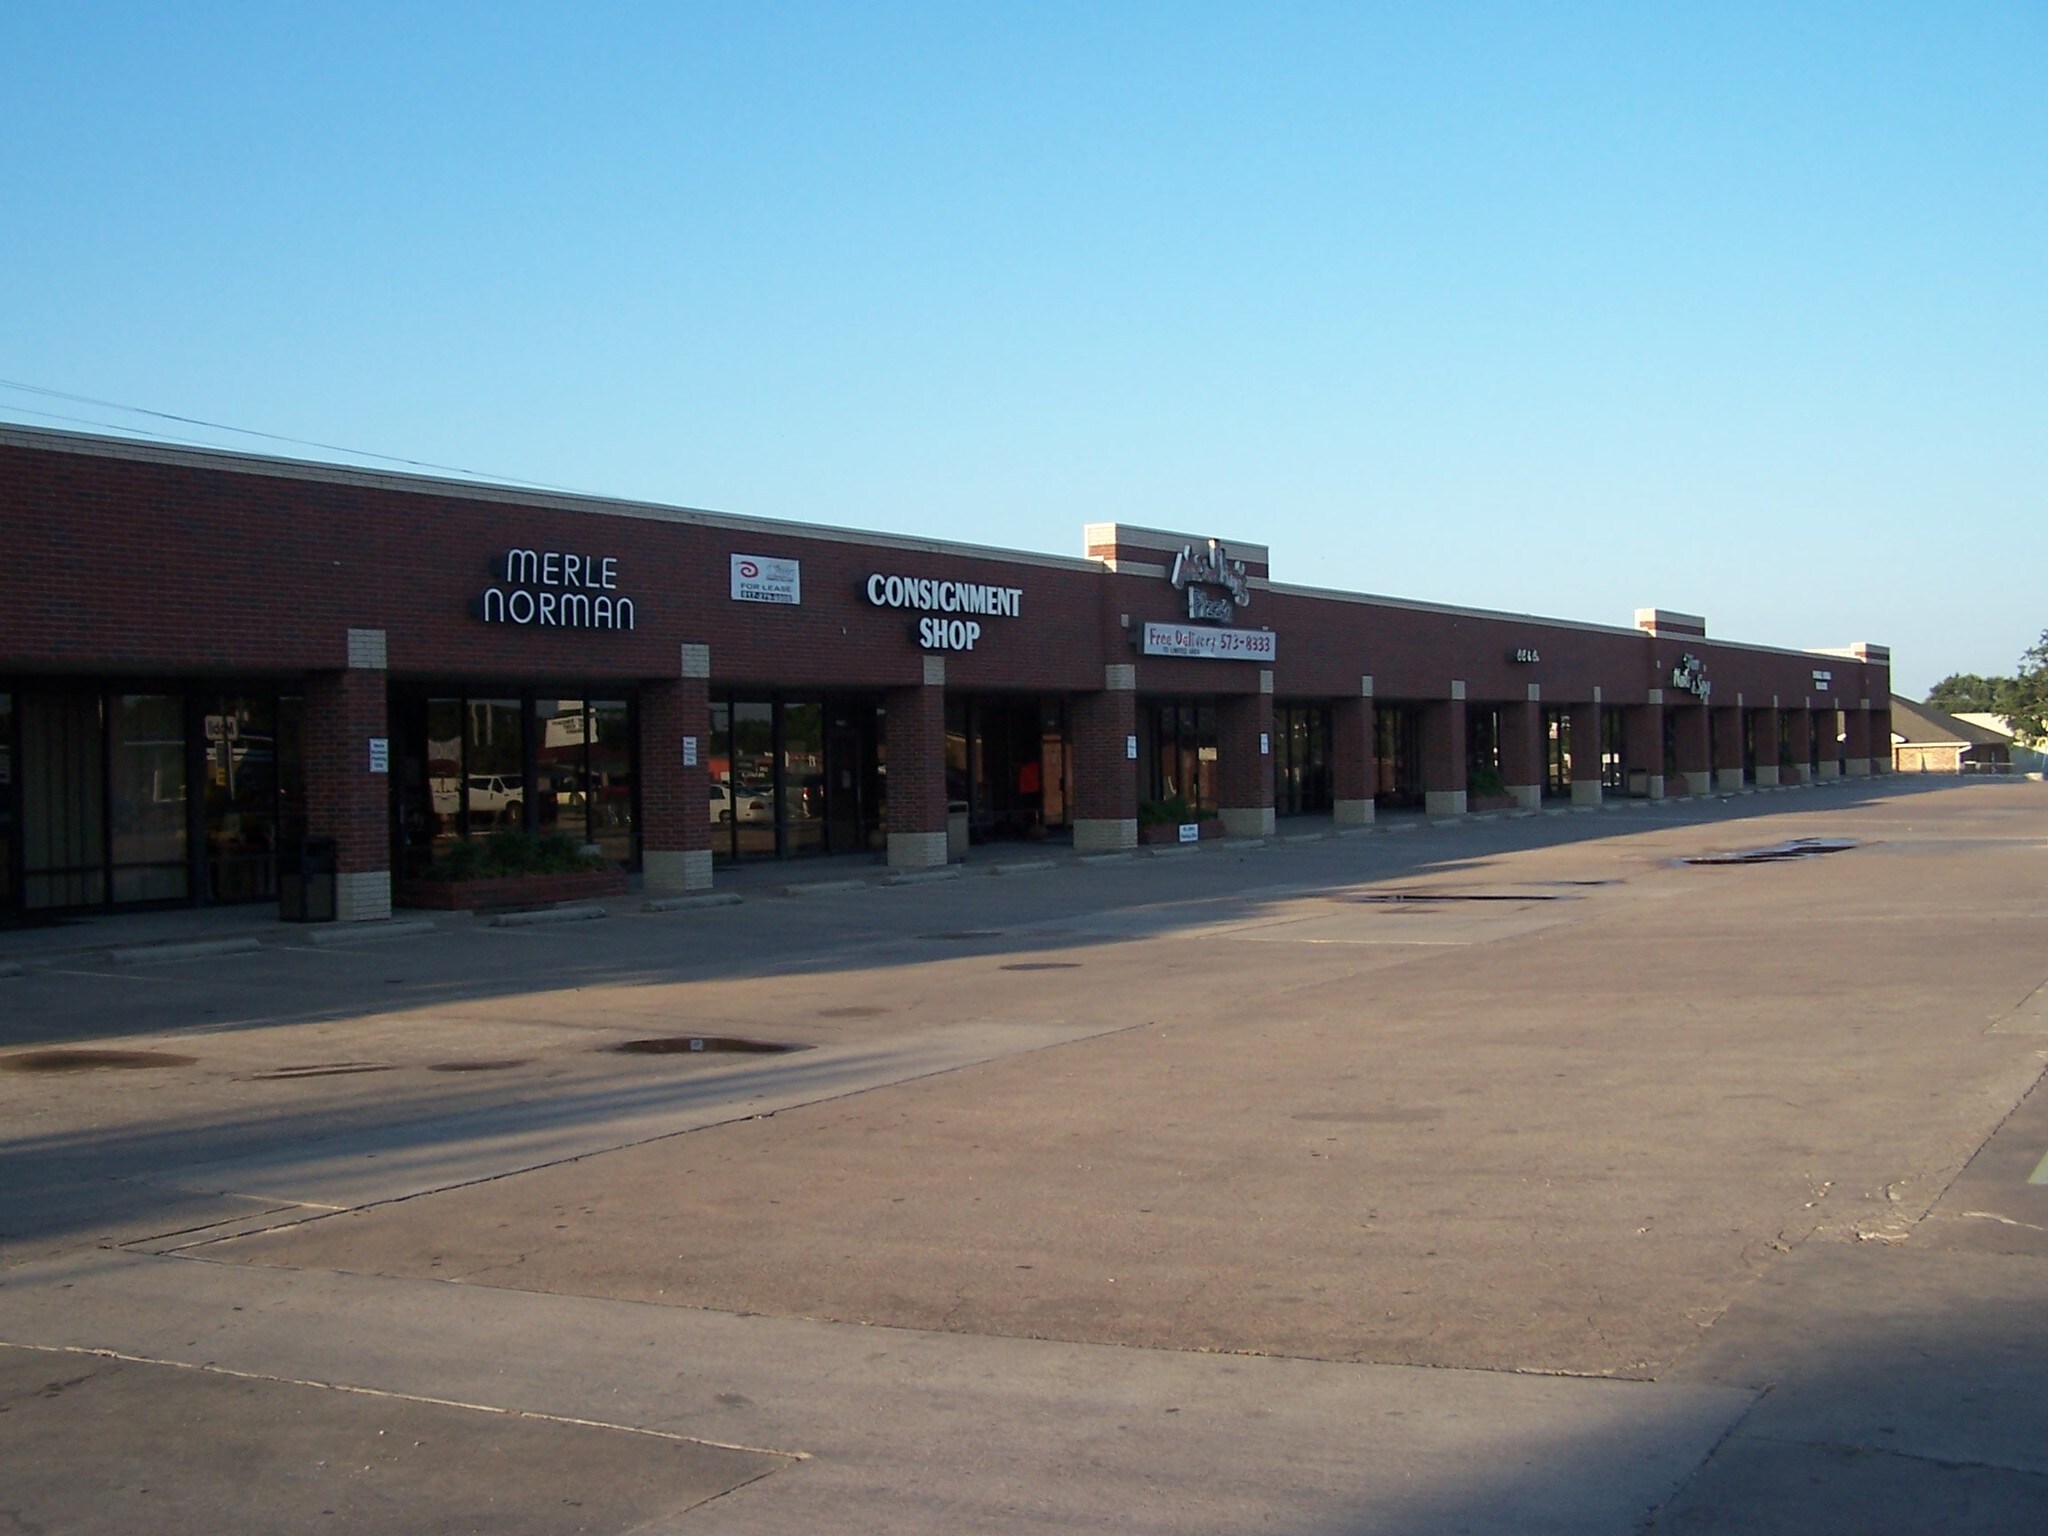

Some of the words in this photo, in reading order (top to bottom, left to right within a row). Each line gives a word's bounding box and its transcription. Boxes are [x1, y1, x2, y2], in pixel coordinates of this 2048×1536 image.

[507, 549, 617, 589] MERLE
[740, 582, 760, 591] FOR
[762, 584, 791, 593] LEASE
[867, 574, 1023, 617] CONSIGNMENT
[484, 588, 634, 630] NORMAN
[919, 617, 980, 650] SHOP
[1150, 628, 1172, 645] Free
[1175, 629, 1216, 653] Delivery
[1220, 634, 1271, 653] 573-8333
